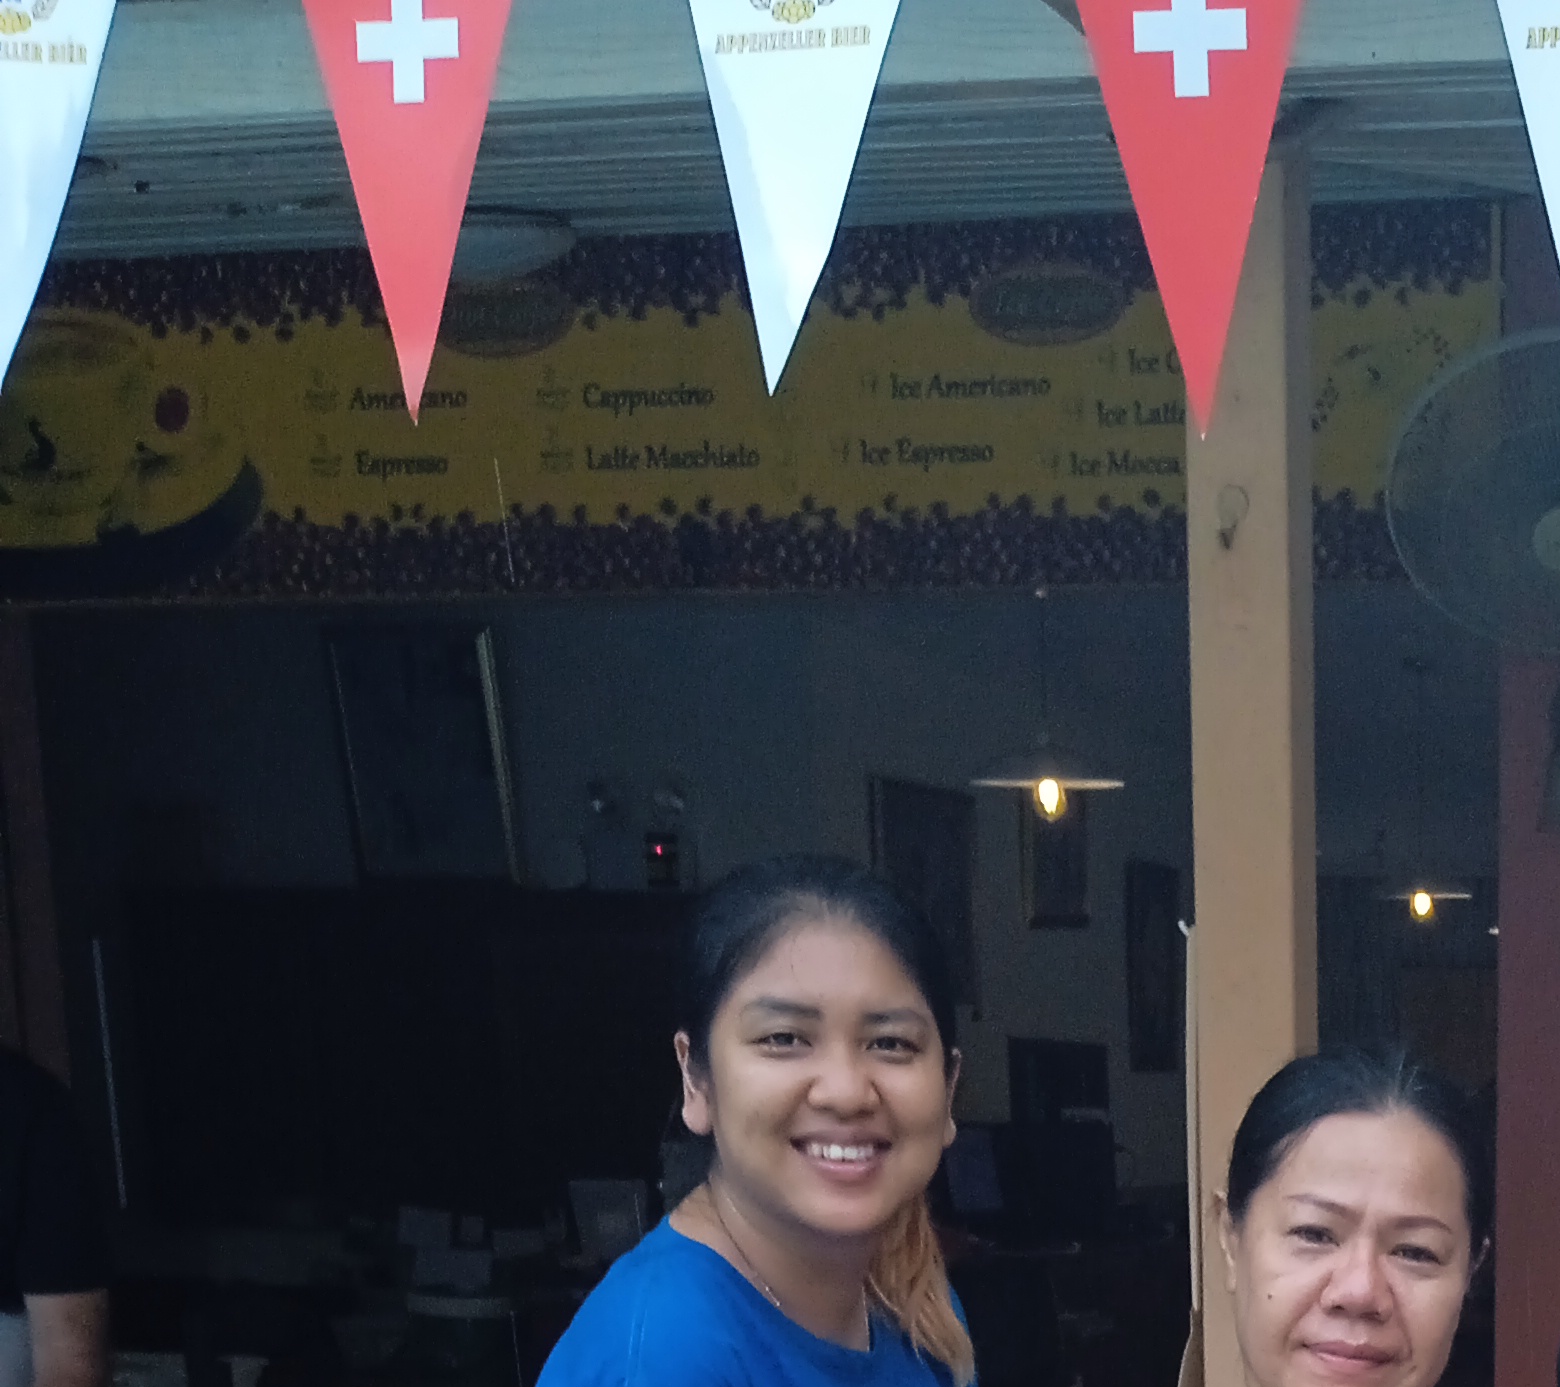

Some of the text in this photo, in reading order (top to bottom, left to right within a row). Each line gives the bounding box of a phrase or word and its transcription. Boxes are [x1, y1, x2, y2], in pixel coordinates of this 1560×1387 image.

[715, 25, 871, 54] APPENZELLER BIER
[583, 382, 714, 417] Cappuccino
[927, 374, 1051, 399] Americano
[355, 449, 449, 481] Espresso
[645, 439, 760, 469] Macchiato
[896, 438, 993, 472] Espresso
